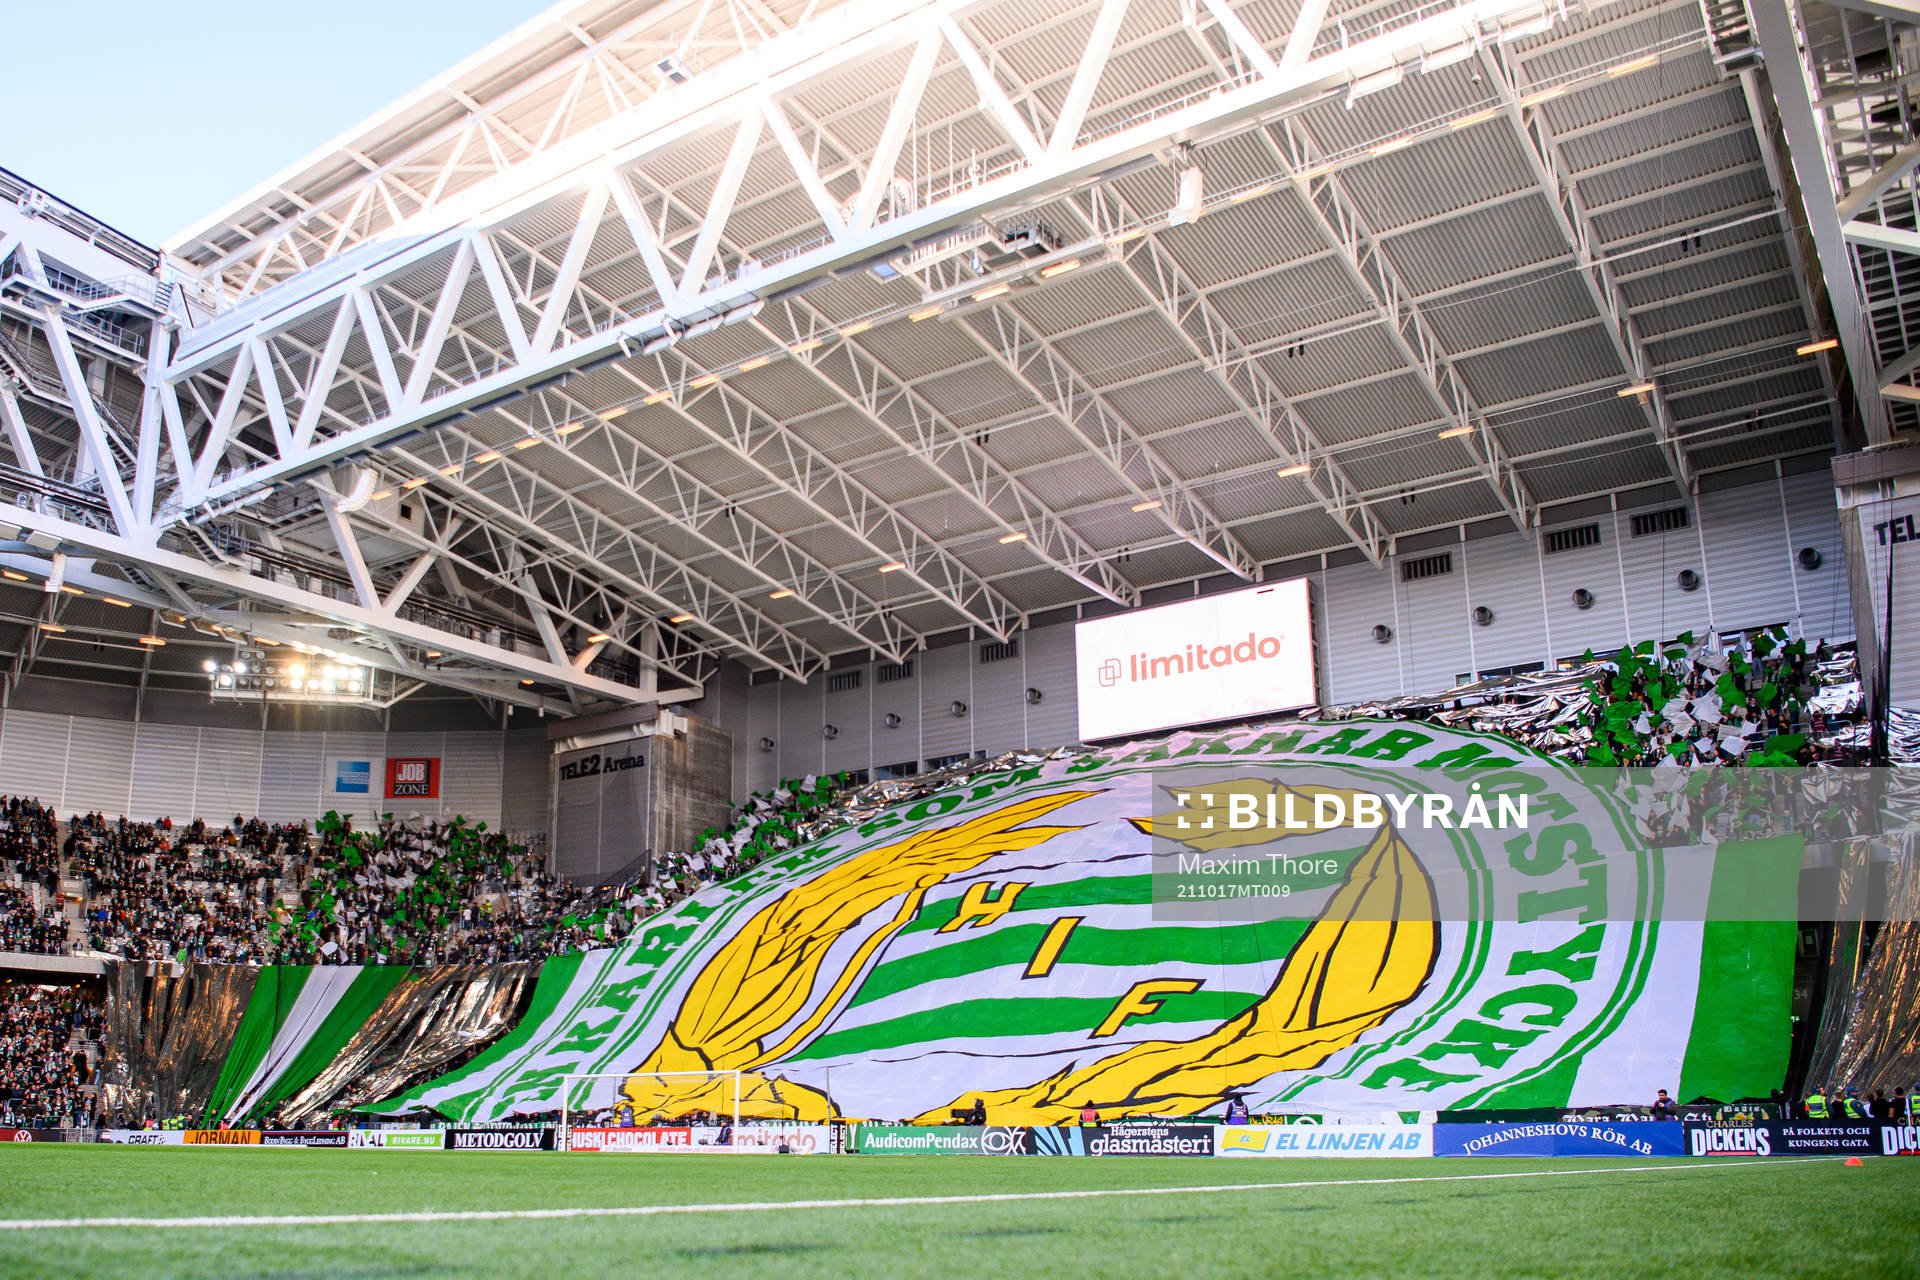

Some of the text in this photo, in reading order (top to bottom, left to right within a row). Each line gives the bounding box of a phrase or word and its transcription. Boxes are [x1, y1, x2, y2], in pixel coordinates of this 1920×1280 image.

[1131, 633, 1281, 682] limitado
[398, 763, 425, 781] JOB
[560, 754, 645, 780] TELE2 Arena
[395, 784, 429, 795] ZONE
[857, 763, 1045, 840] SOM
[1111, 1126, 1169, 1138] Hägerstens
[1706, 1120, 1754, 1128] CHARLES
[1783, 1127, 1870, 1136] PÅ FOLKETS OCH
[128, 1135, 159, 1144] CRAFT
[336, 1136, 346, 1144] AB
[392, 1136, 436, 1145] RIVARE.NU
[455, 1132, 544, 1148] METODGOLV
[607, 1131, 688, 1147] CHOCOLATE
[864, 1132, 979, 1149] AudicomPendax
[1090, 1134, 1212, 1156] glasmästeri
[1276, 1133, 1422, 1150] EL LINJEN AB
[1463, 1124, 1653, 1156] JOHANNESHOVS RÖR AB
[1691, 1128, 1771, 1156] DICKENS
[1789, 1139, 1869, 1148] KUNGENS GATA
